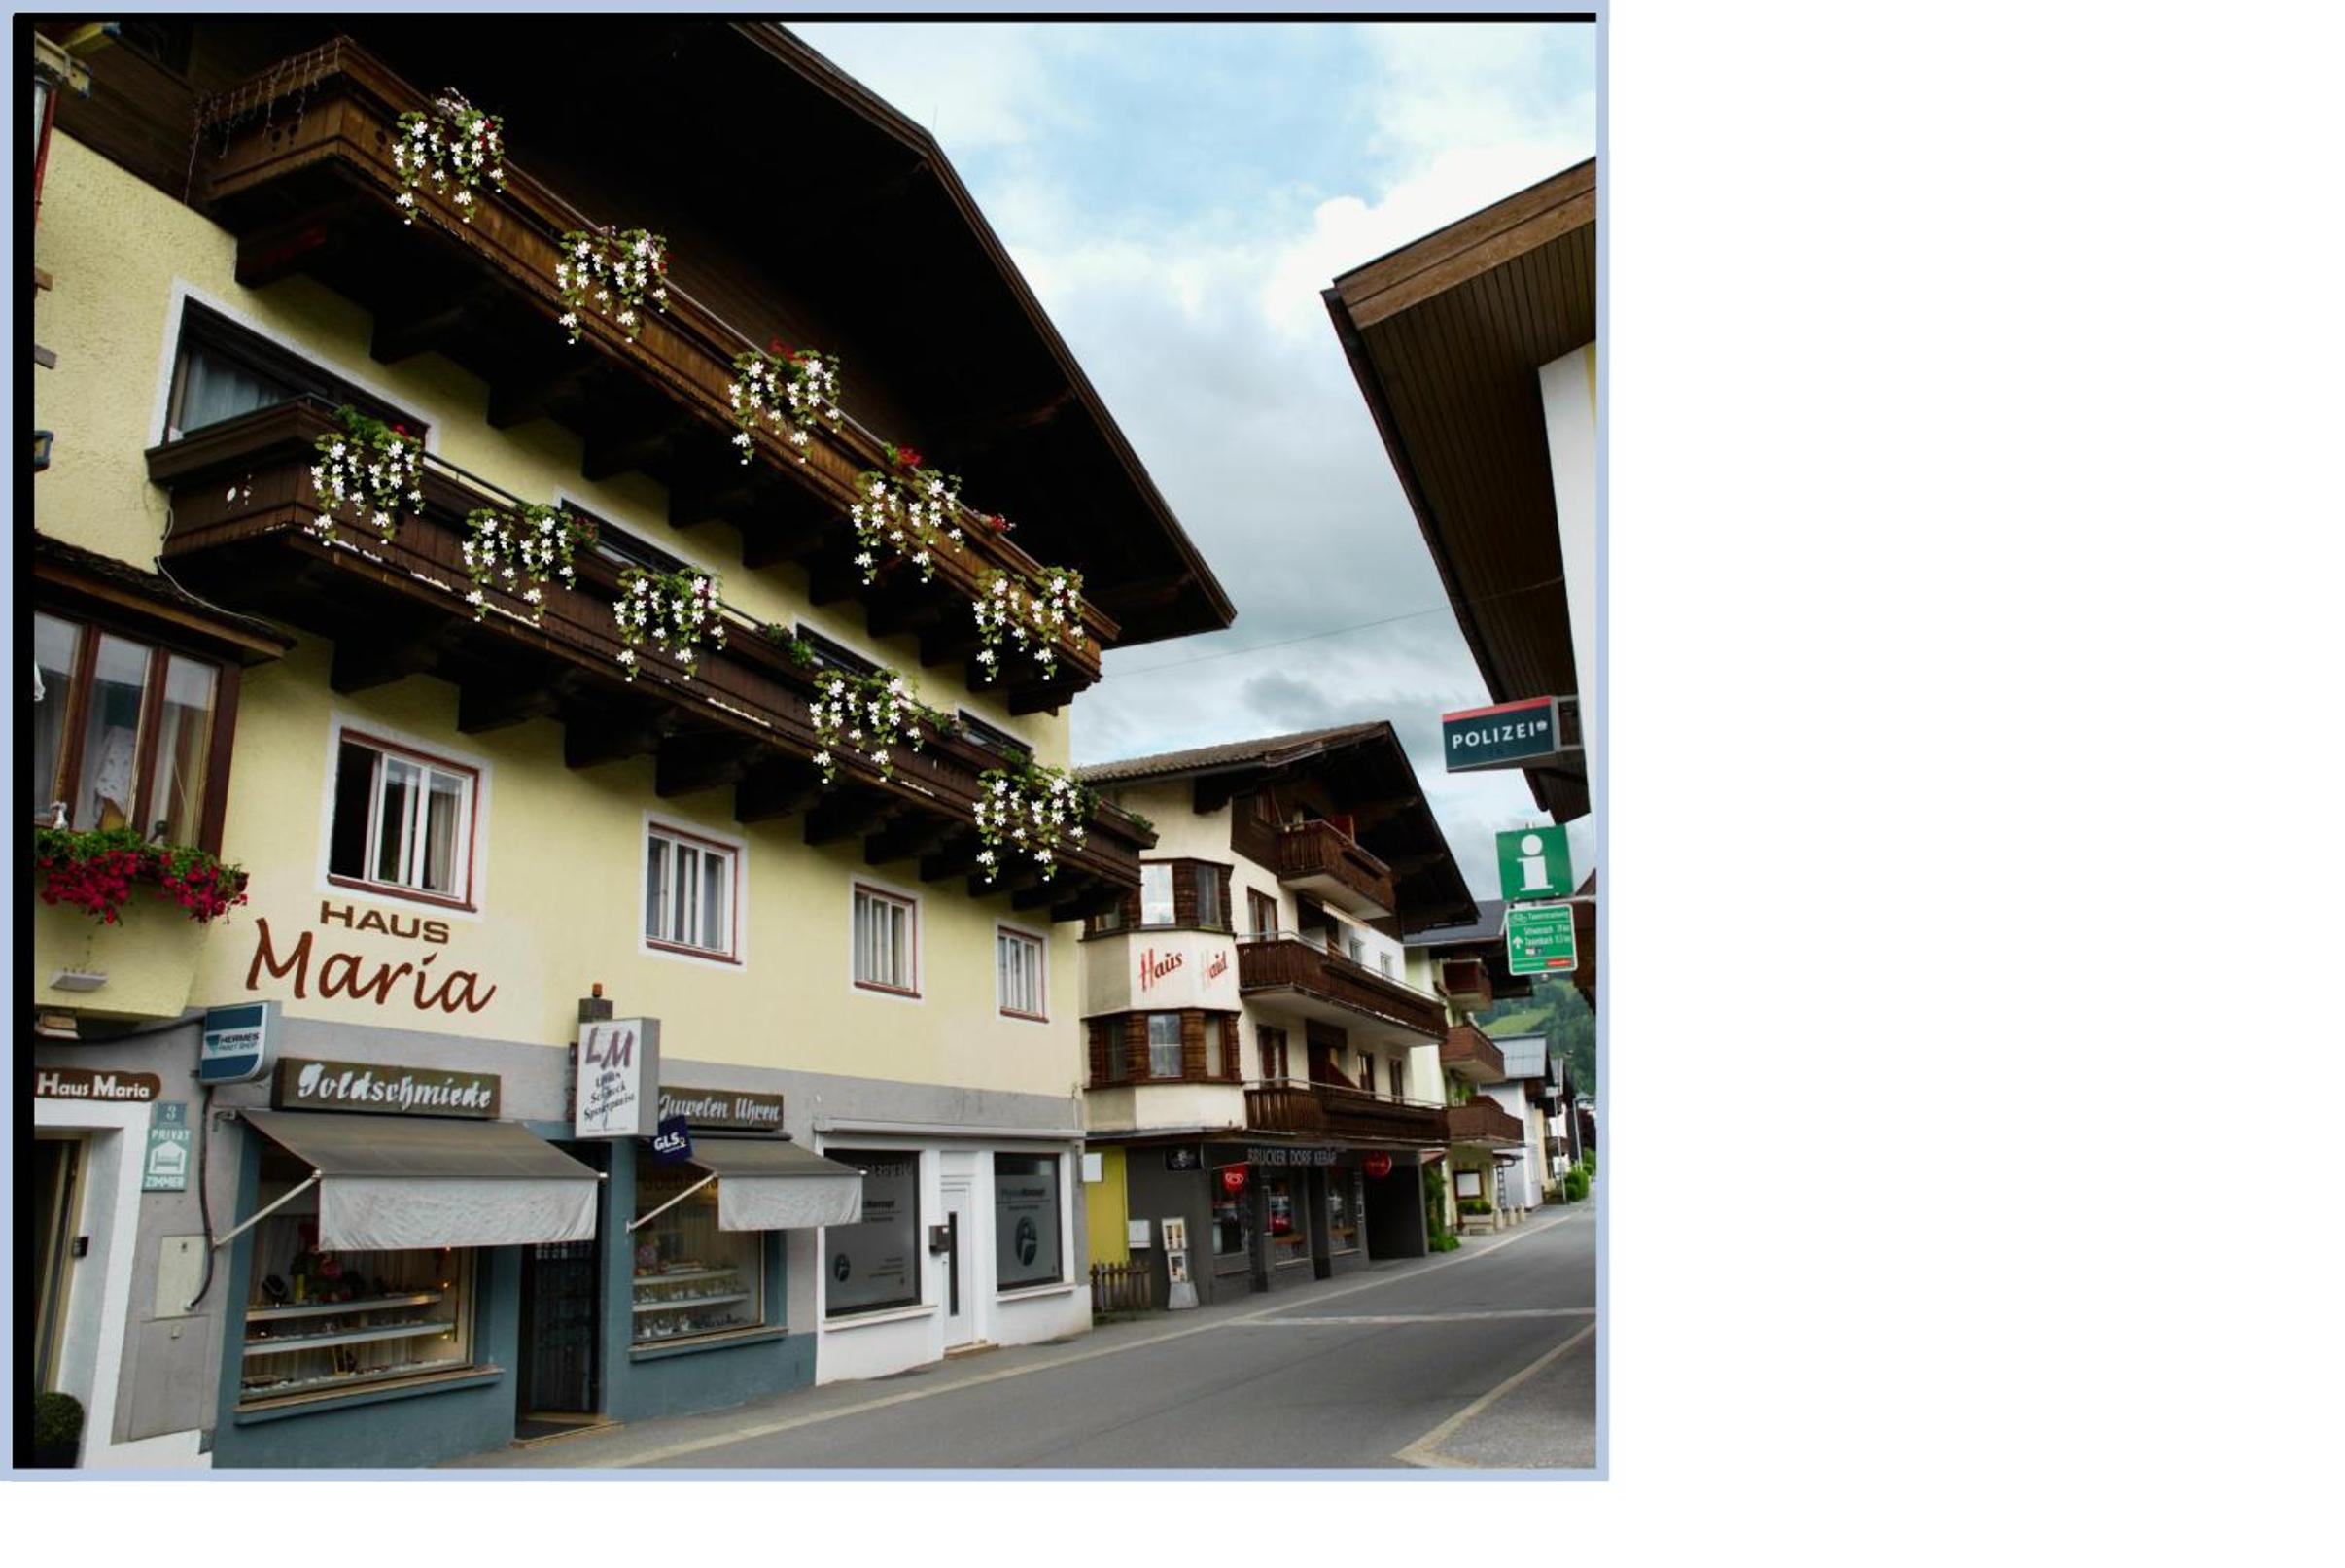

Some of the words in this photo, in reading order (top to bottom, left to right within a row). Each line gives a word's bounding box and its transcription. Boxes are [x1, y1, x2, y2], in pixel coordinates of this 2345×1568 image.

[1452, 720, 1536, 749] POLIZEI
[320, 900, 450, 945] HAUS
[220, 1032, 260, 1043] HERMES
[585, 1026, 634, 1069] LM
[36, 1072, 89, 1096] Haus
[92, 1074, 150, 1098] Maria
[298, 1063, 491, 1112] Goldschmiede
[659, 1094, 729, 1121] Juwelen
[734, 1098, 780, 1126] Uhren
[150, 1129, 191, 1141] PRIVAT
[653, 1132, 680, 1151] GLS
[145, 1175, 185, 1188] ZIMMER
